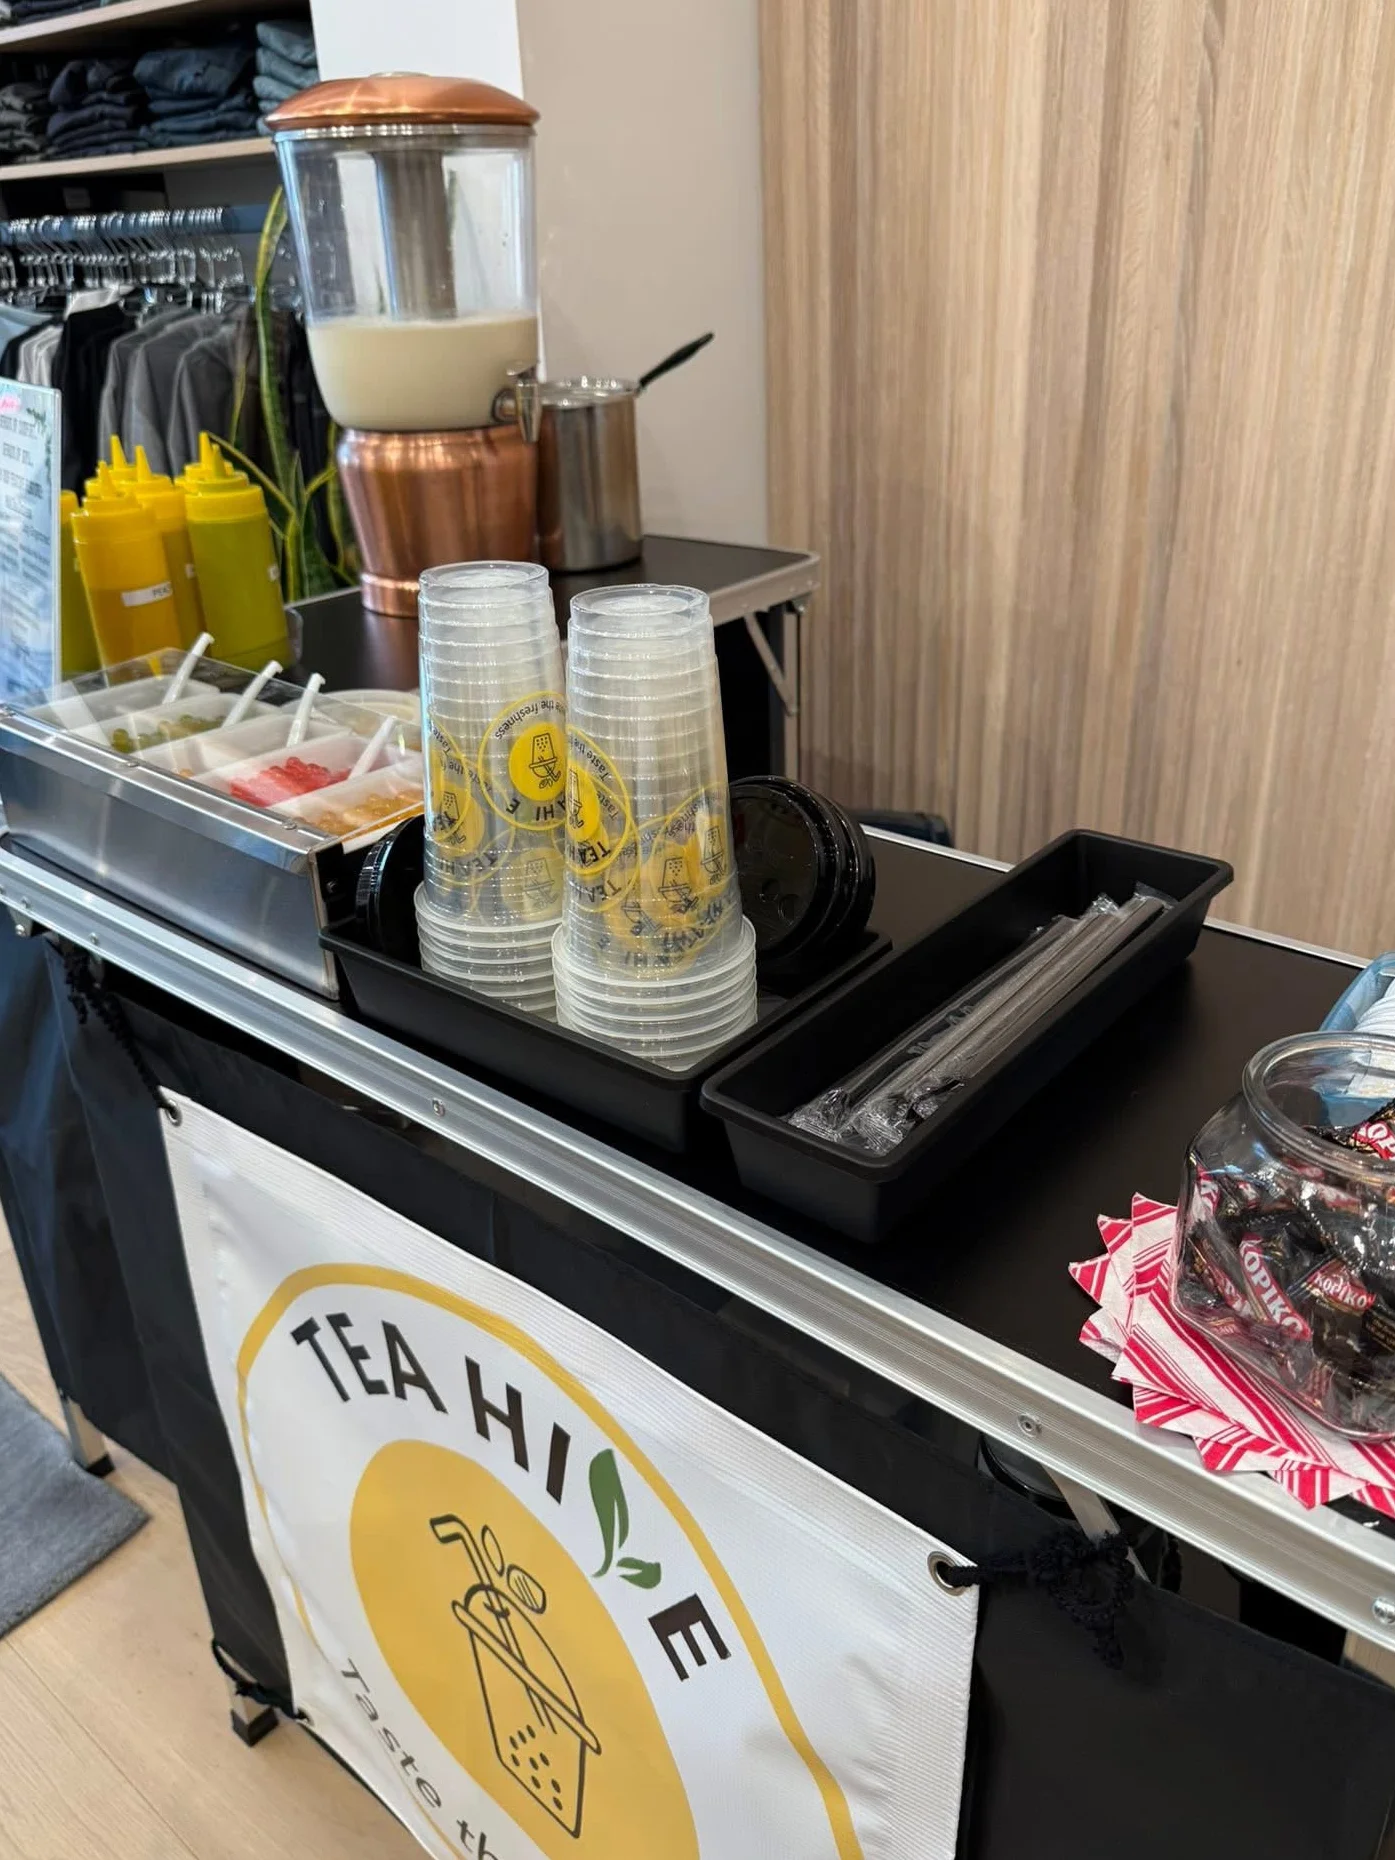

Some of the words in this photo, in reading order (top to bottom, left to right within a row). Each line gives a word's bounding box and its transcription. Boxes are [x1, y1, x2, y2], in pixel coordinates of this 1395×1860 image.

[494, 705, 538, 741] freshness
[586, 750, 613, 783] Taste
[290, 1312, 449, 1414] TEA
[341, 1657, 442, 1808] Taste
